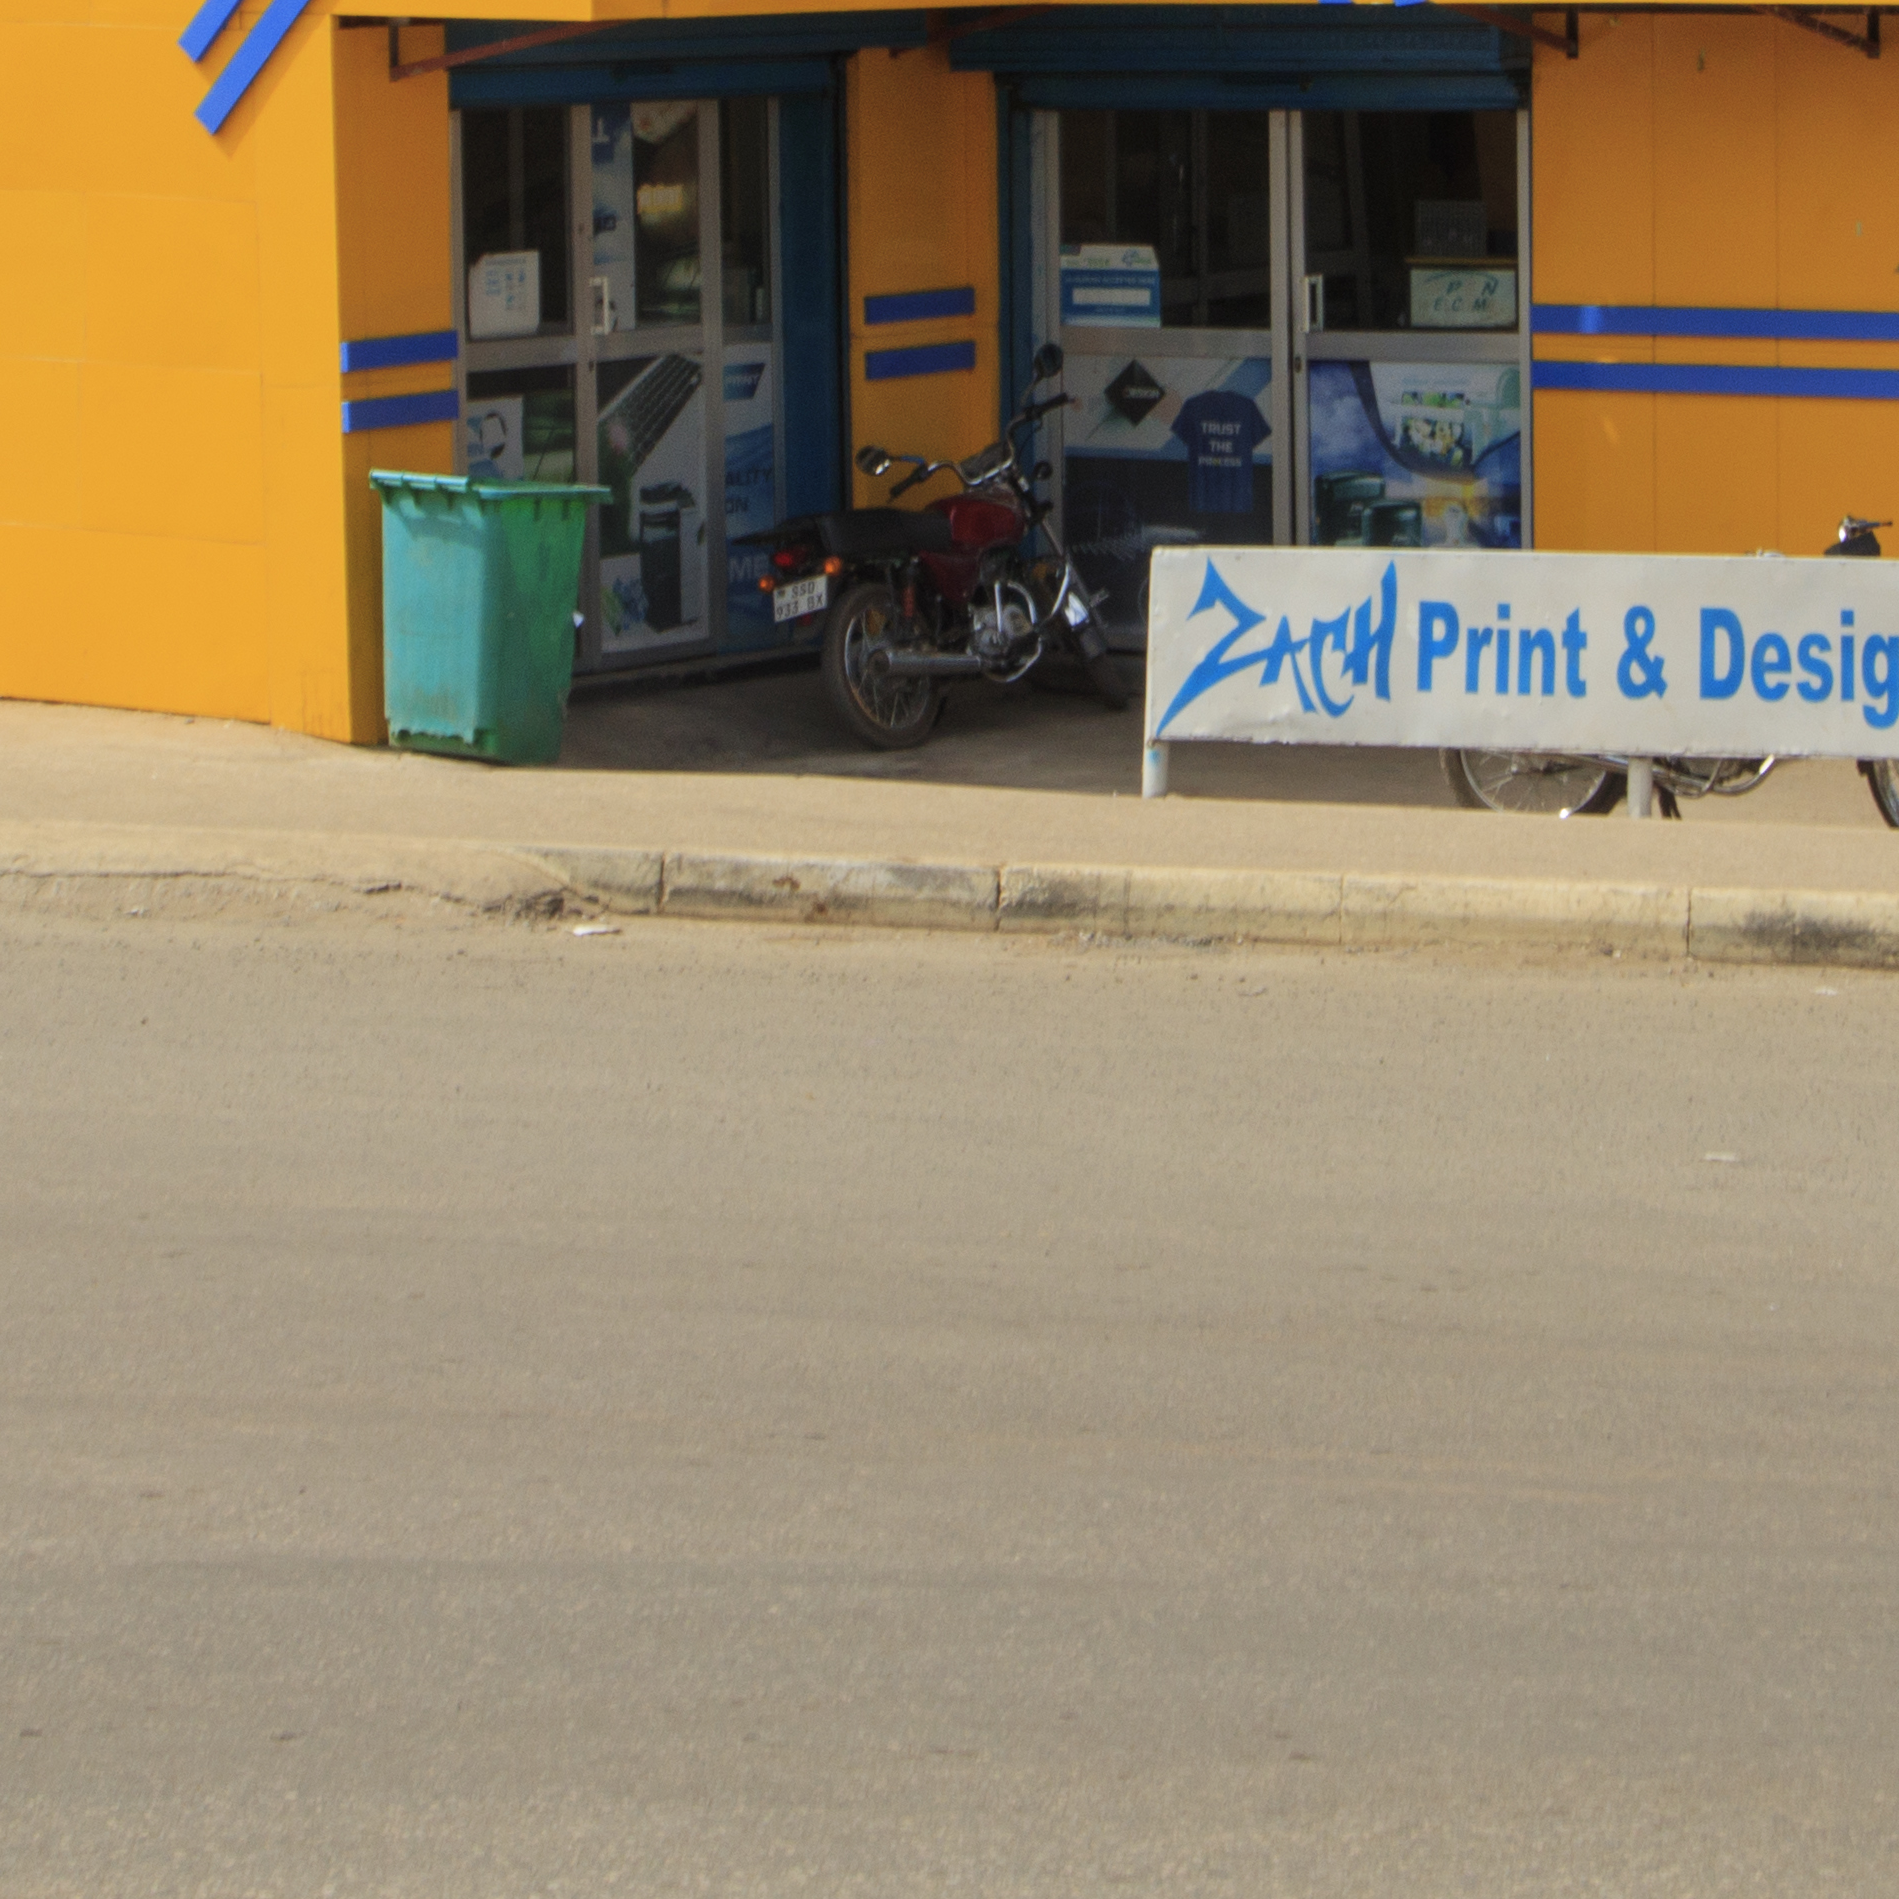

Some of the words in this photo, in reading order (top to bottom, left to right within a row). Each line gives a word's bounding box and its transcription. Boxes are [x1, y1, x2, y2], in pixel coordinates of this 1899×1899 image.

[1200, 420, 1243, 436] TRUST
[1209, 439, 1234, 454] THE
[1417, 599, 1590, 700] Print
[1616, 604, 1670, 701] &
